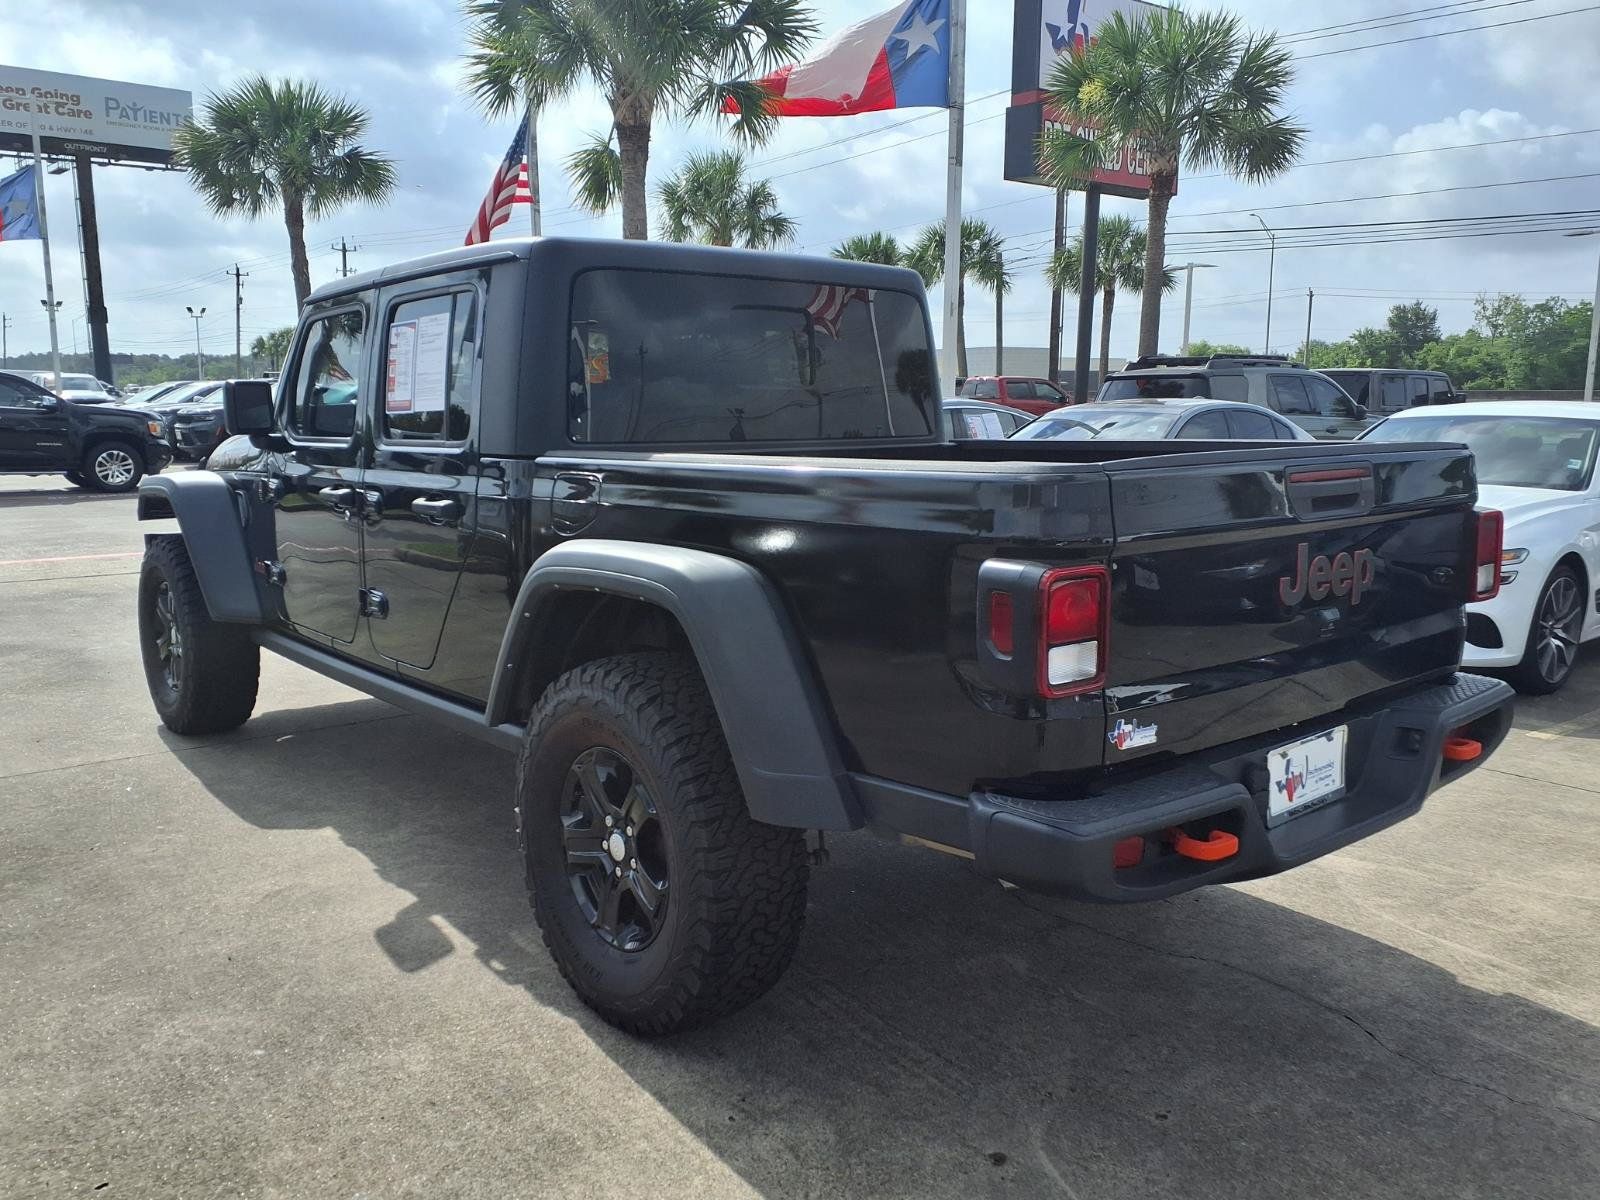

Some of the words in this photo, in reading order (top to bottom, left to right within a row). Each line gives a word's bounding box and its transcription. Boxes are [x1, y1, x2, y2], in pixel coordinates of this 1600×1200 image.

[30, 86, 81, 106] Going
[54, 101, 93, 120] Care
[1279, 542, 1376, 607] Jeep
